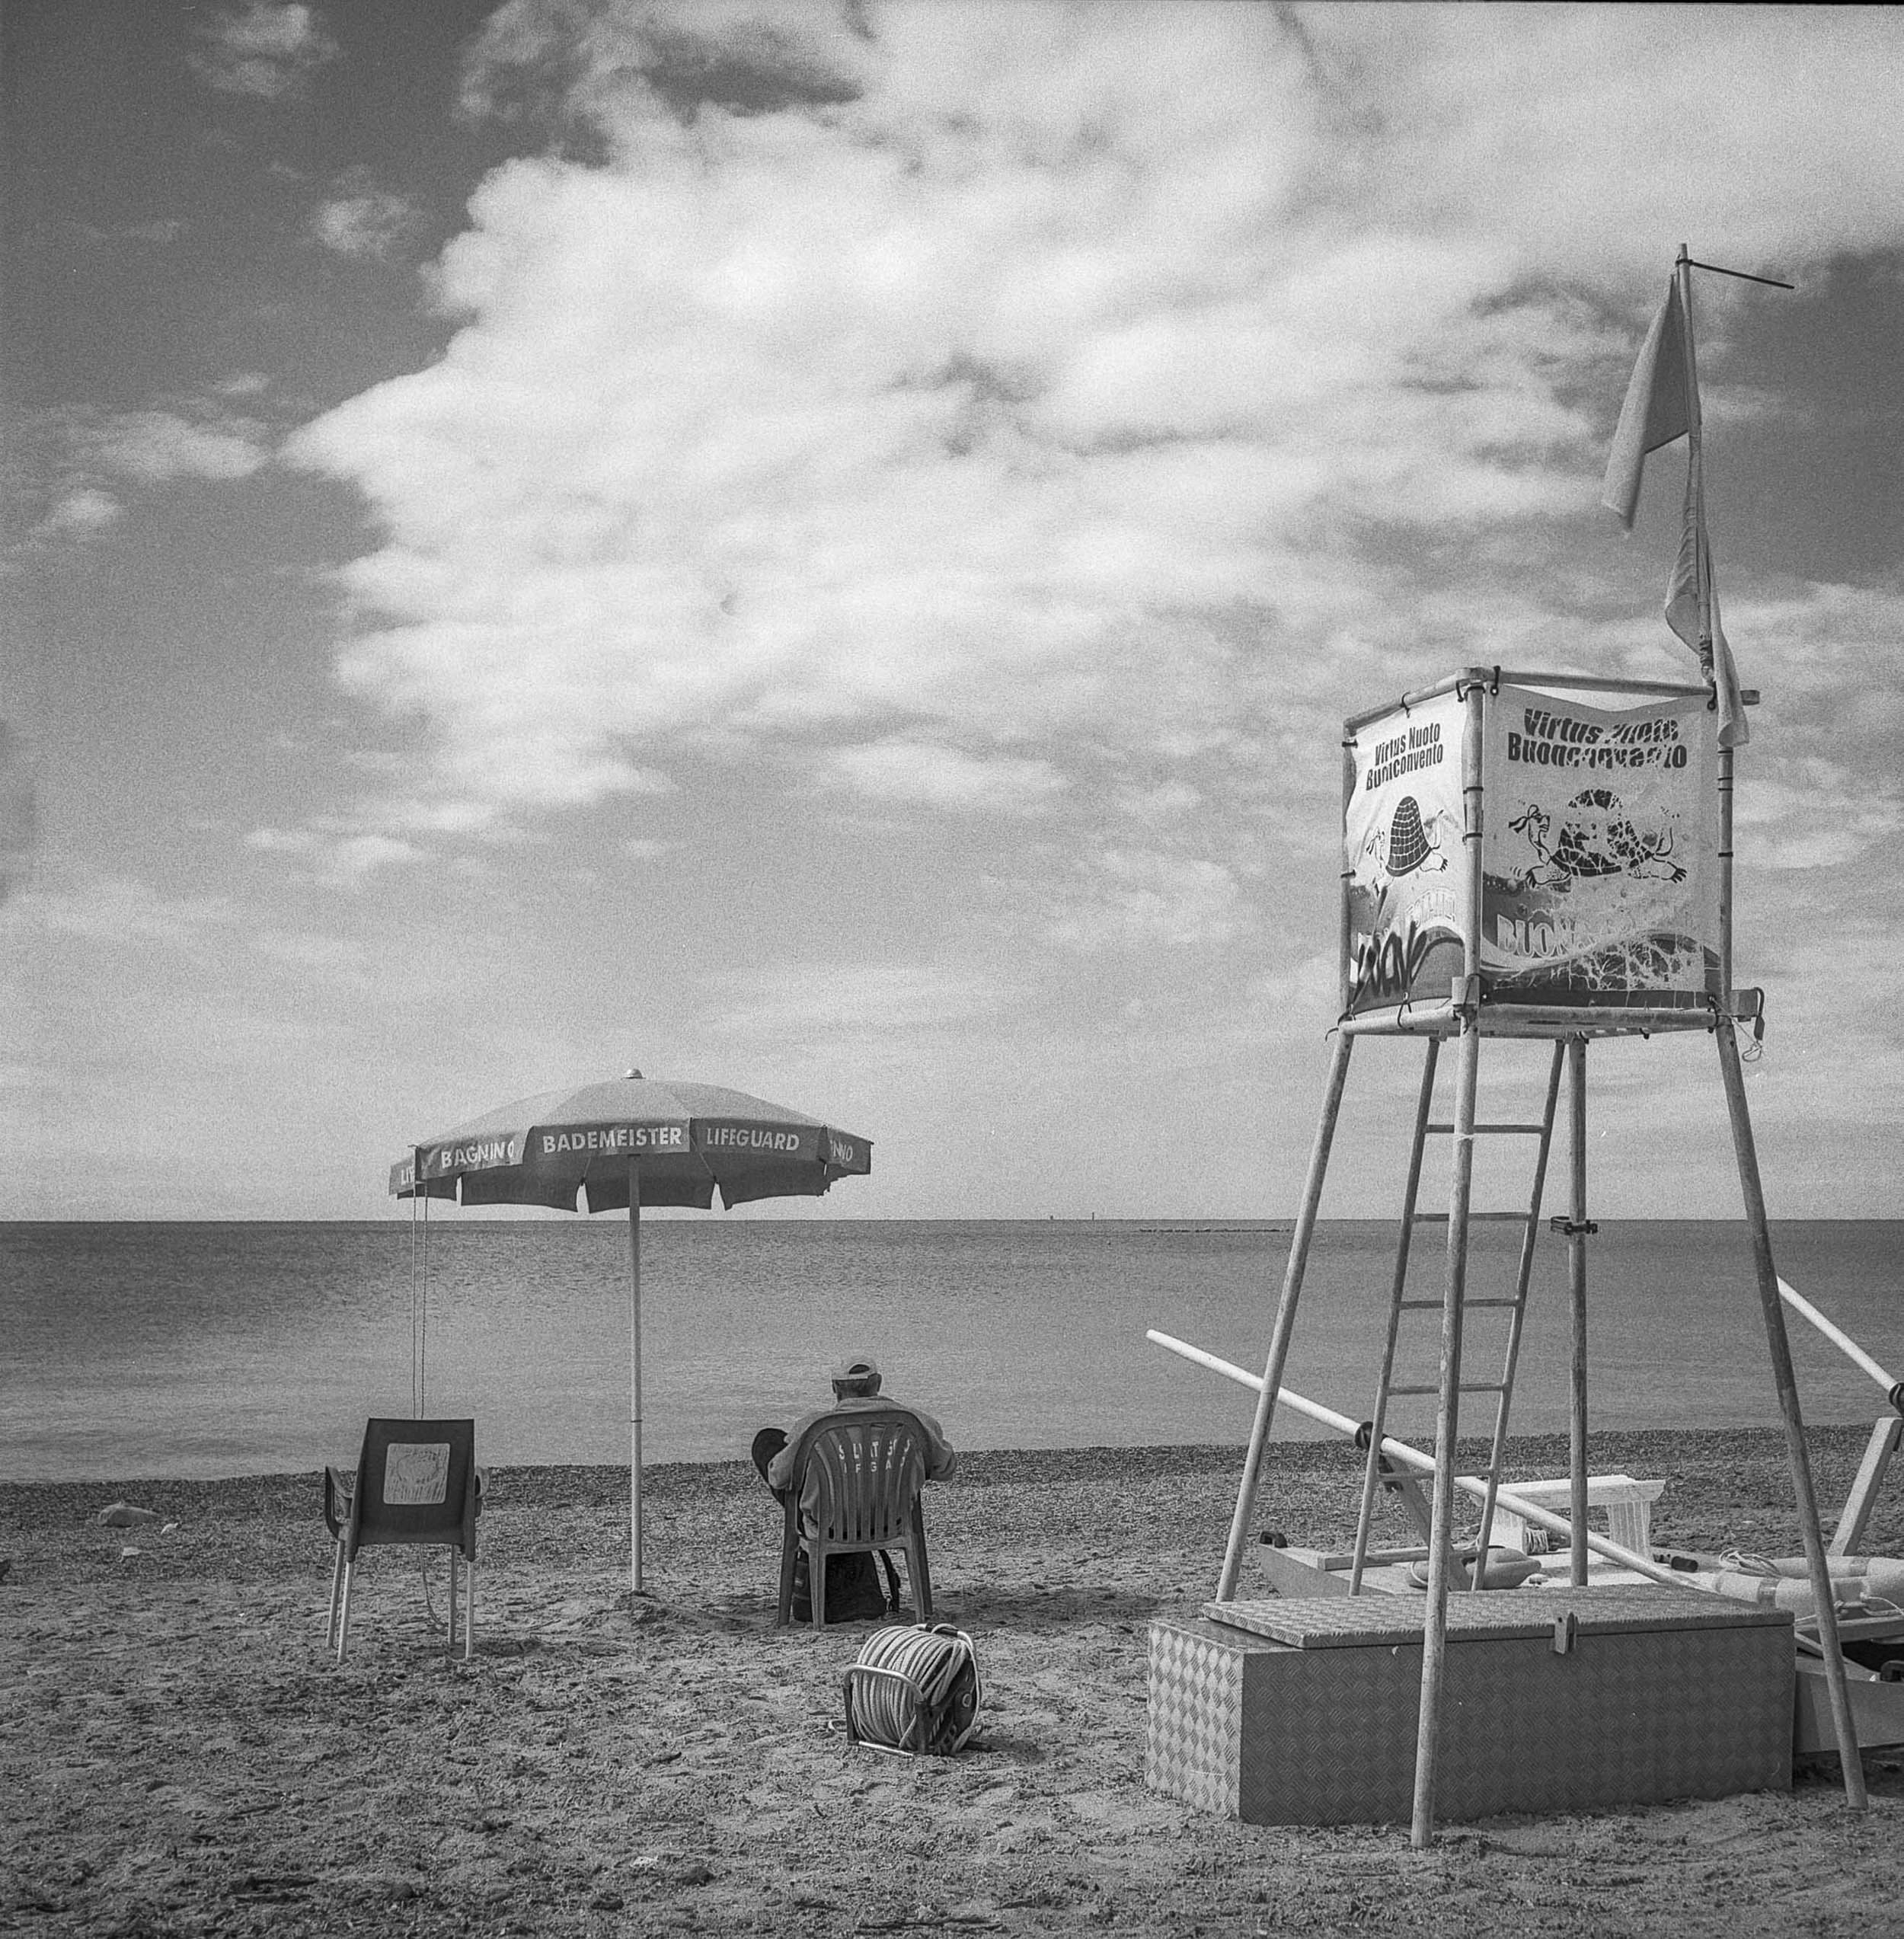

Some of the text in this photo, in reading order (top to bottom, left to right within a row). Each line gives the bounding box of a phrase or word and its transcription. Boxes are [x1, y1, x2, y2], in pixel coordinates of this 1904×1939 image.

[1524, 708, 1604, 744] Virtus
[1375, 722, 1441, 767] Virtus Nuoto
[542, 1126, 682, 1154] BADEMEISTER
[706, 1127, 800, 1151] LIFEGUARD
[441, 1140, 515, 1169] BAGNINO
